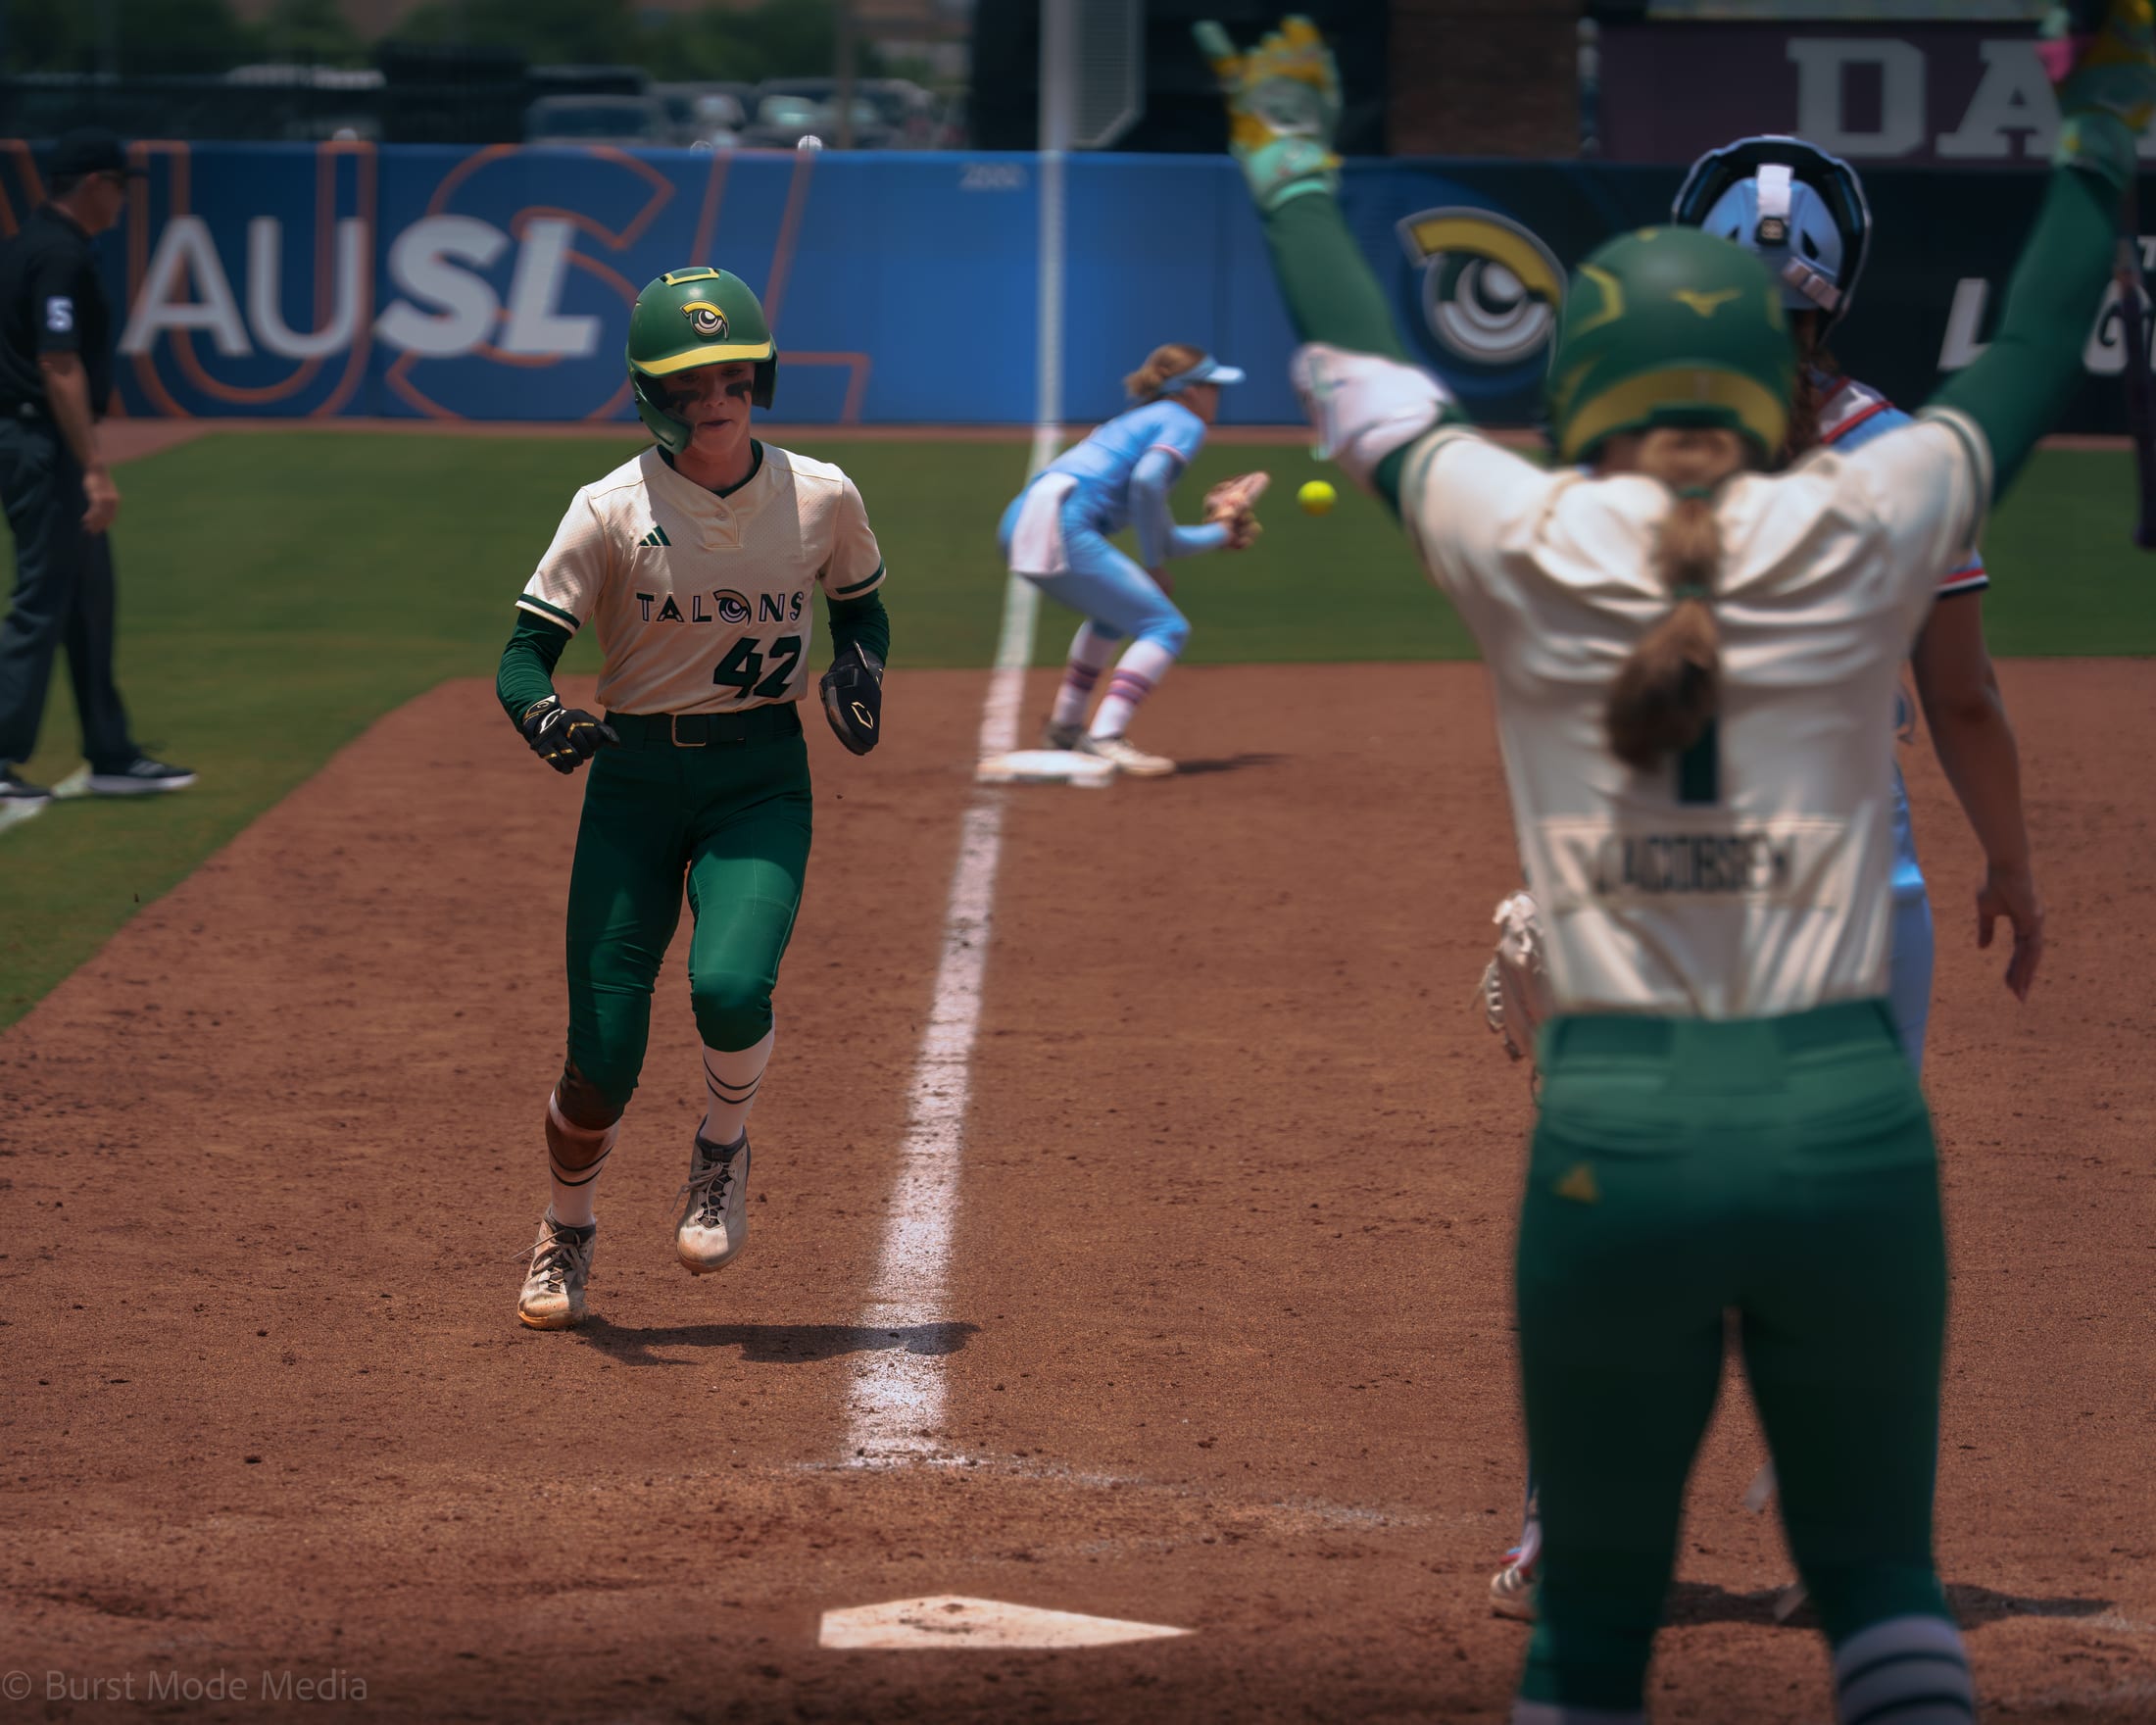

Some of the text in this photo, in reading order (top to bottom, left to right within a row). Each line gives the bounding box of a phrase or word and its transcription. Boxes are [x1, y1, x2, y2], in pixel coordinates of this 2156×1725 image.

[1787, 37, 2156, 158] DA
[120, 215, 601, 359] AUSL
[636, 589, 805, 626] TALONS
[713, 635, 802, 698] 42
